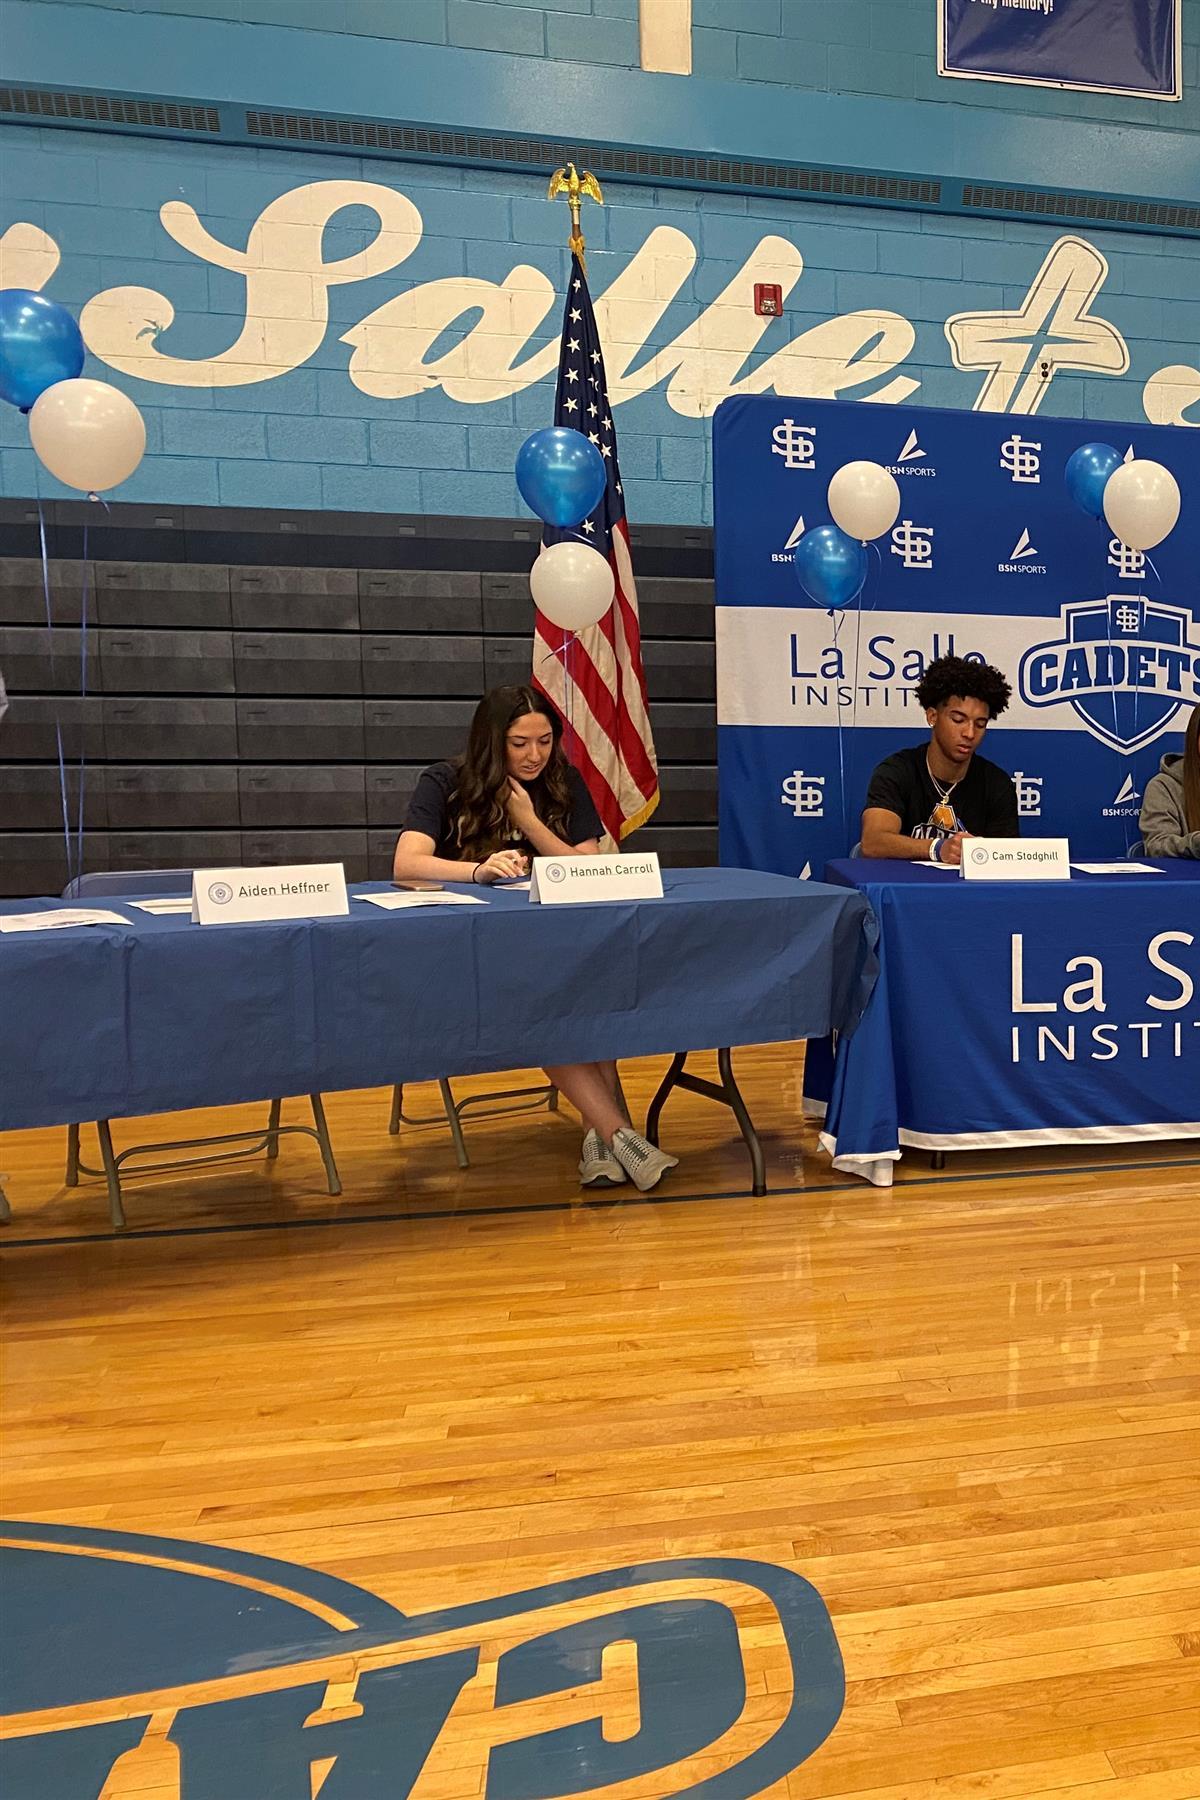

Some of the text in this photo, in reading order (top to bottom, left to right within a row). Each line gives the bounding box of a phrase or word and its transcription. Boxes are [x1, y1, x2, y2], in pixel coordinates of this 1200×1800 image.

[80, 180, 922, 417] Salle
[790, 634, 845, 680] La
[791, 685, 918, 707] INSTIT
[992, 851, 1059, 862] Cam Stodghill
[570, 863, 653, 877] Hannah Carroll
[238, 882, 330, 897] Aiden Heffner
[1012, 933, 1107, 1013] La
